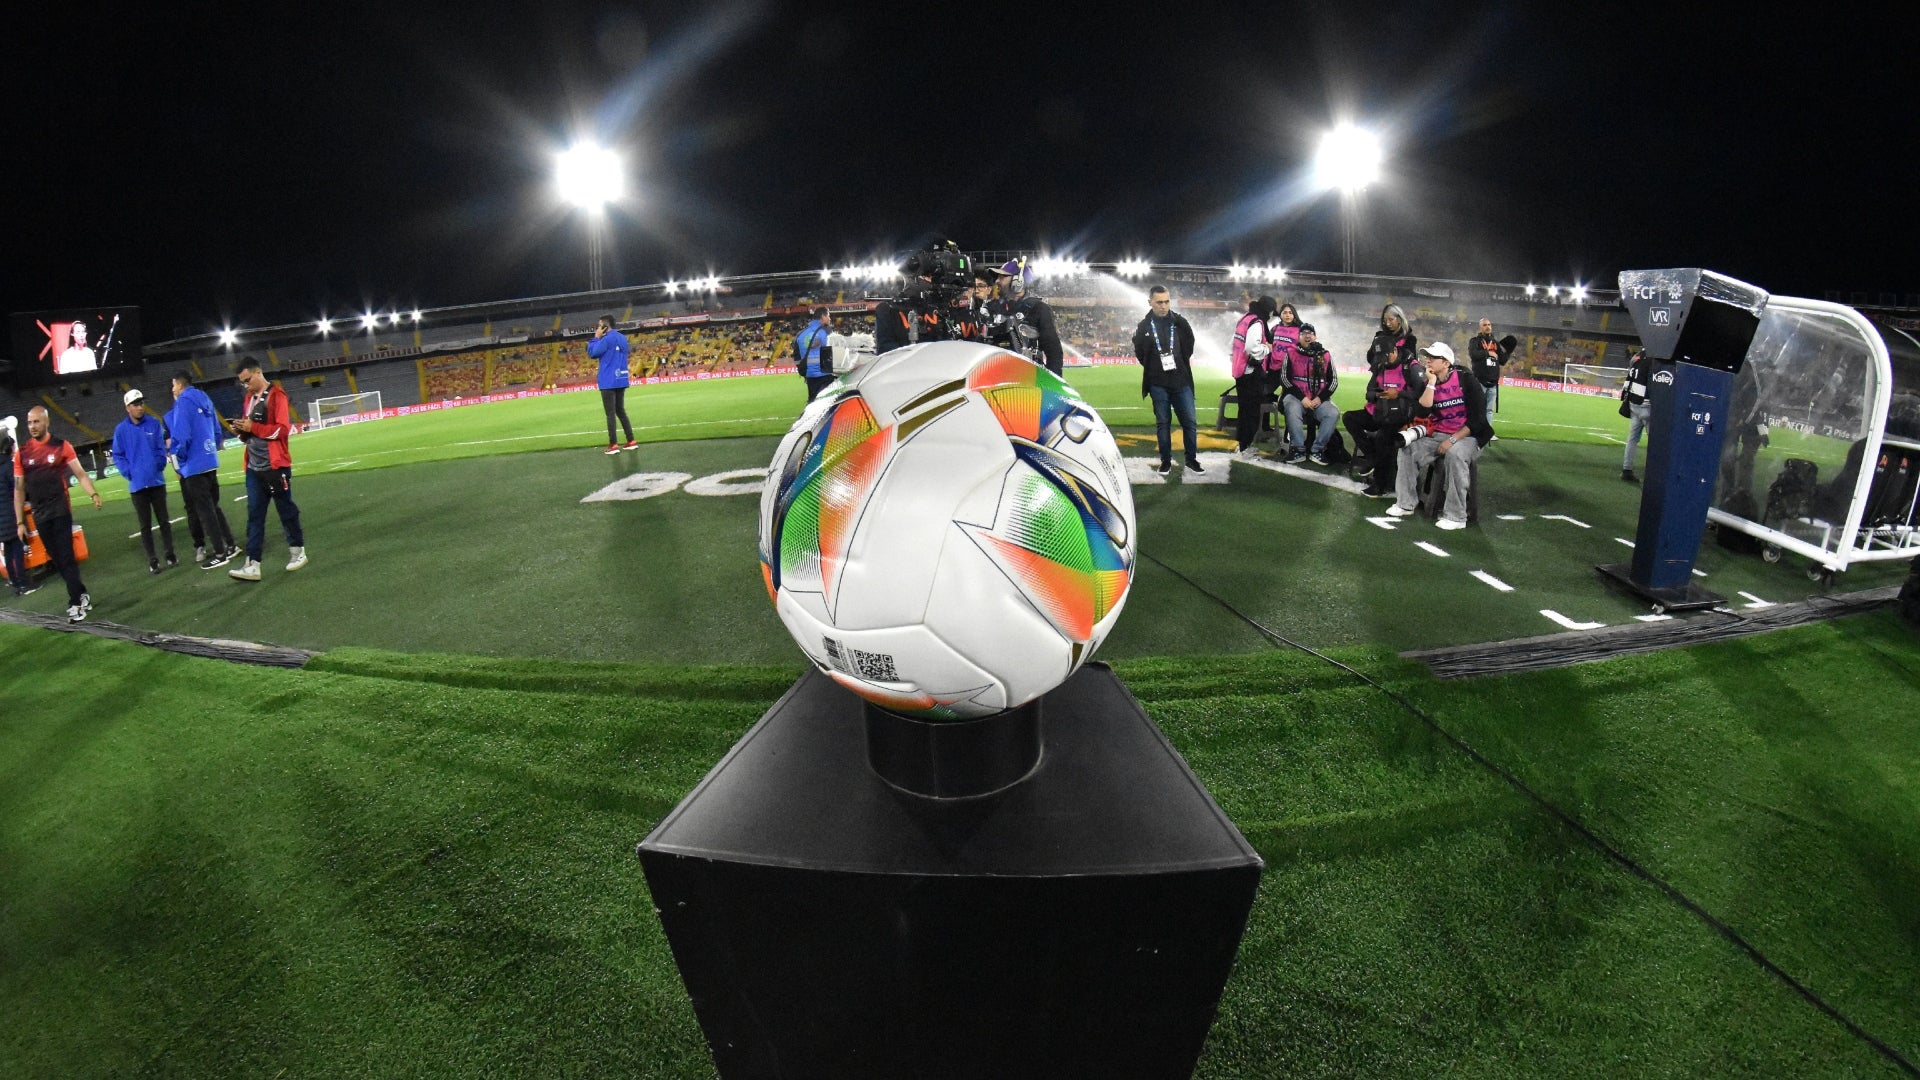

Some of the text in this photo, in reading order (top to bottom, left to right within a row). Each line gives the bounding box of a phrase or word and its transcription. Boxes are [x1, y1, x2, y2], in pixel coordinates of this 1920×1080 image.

[1632, 286, 1656, 300] FCF
[1651, 310, 1668, 323] VAR
[1105, 357, 1115, 365] DE
[1652, 372, 1674, 386] Kalley
[1442, 398, 1465, 407] OFICIAL
